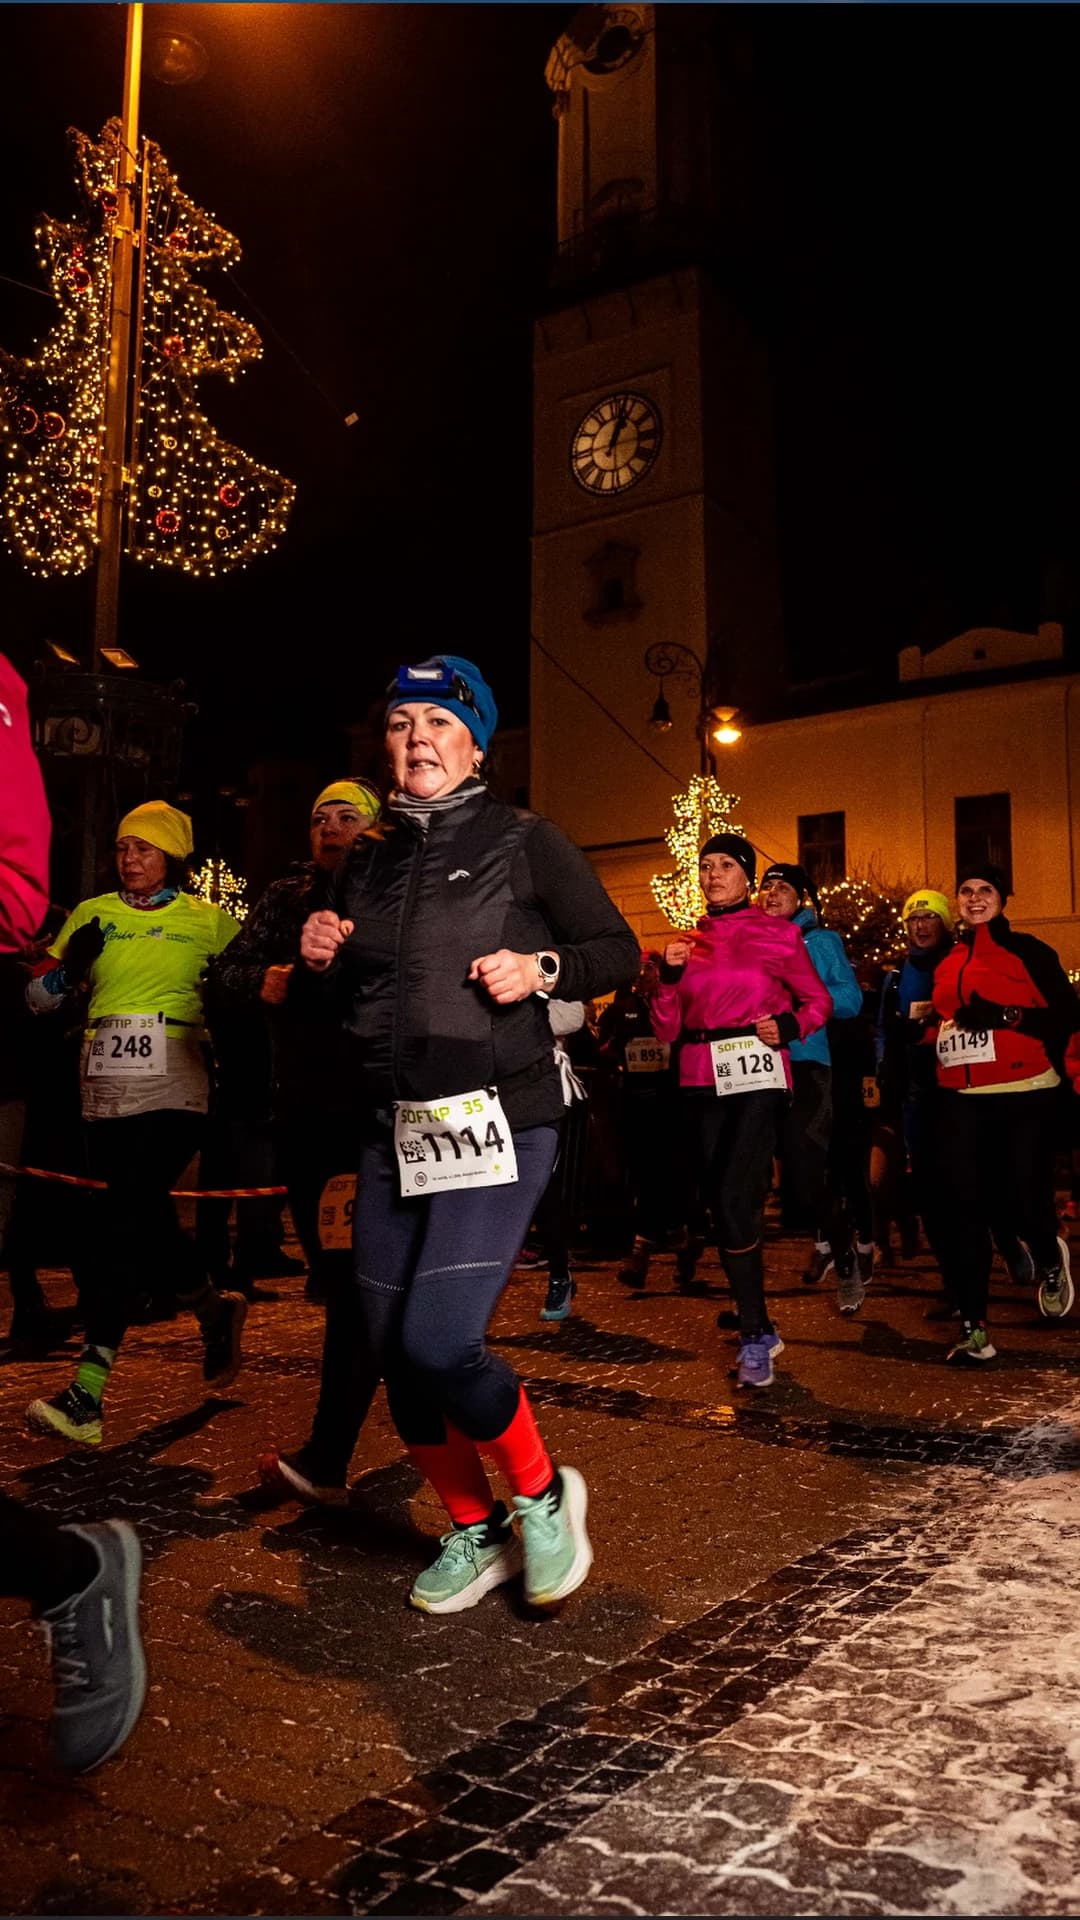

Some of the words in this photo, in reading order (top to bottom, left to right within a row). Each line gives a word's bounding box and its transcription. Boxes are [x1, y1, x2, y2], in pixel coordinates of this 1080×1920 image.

[140, 1019, 154, 1028] 35
[111, 1035, 152, 1058] 248
[717, 1040, 754, 1053] SOFTIP
[949, 1031, 989, 1051] 1149
[641, 1048, 663, 1062] 895
[737, 1053, 774, 1075] 128
[401, 1107, 450, 1124] SOFTIP
[462, 1098, 484, 1115] 35
[421, 1121, 504, 1162] 1114
